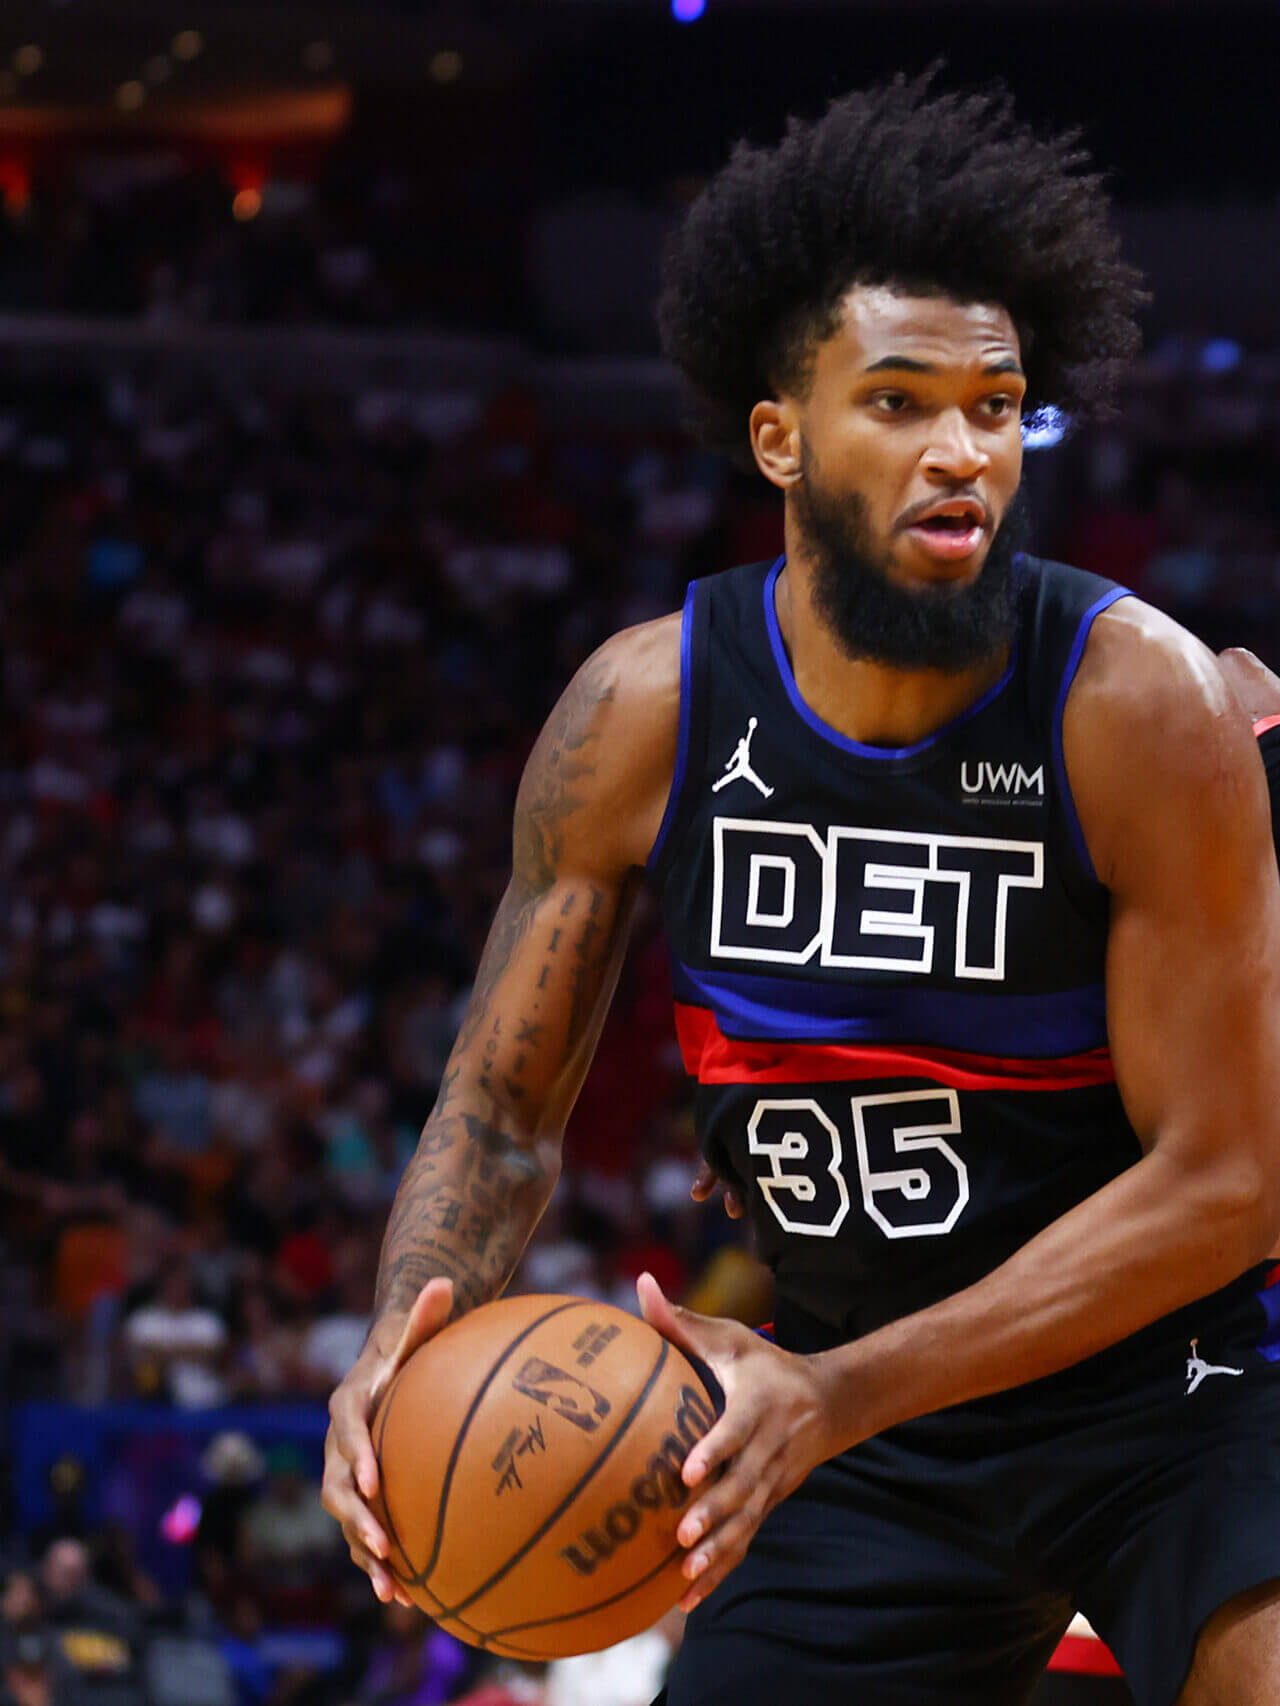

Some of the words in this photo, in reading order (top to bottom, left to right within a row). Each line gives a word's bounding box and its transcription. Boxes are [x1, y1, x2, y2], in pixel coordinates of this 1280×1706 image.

[961, 761, 1044, 796] UWM
[710, 816, 1044, 981] DET
[747, 1088, 970, 1239] 35
